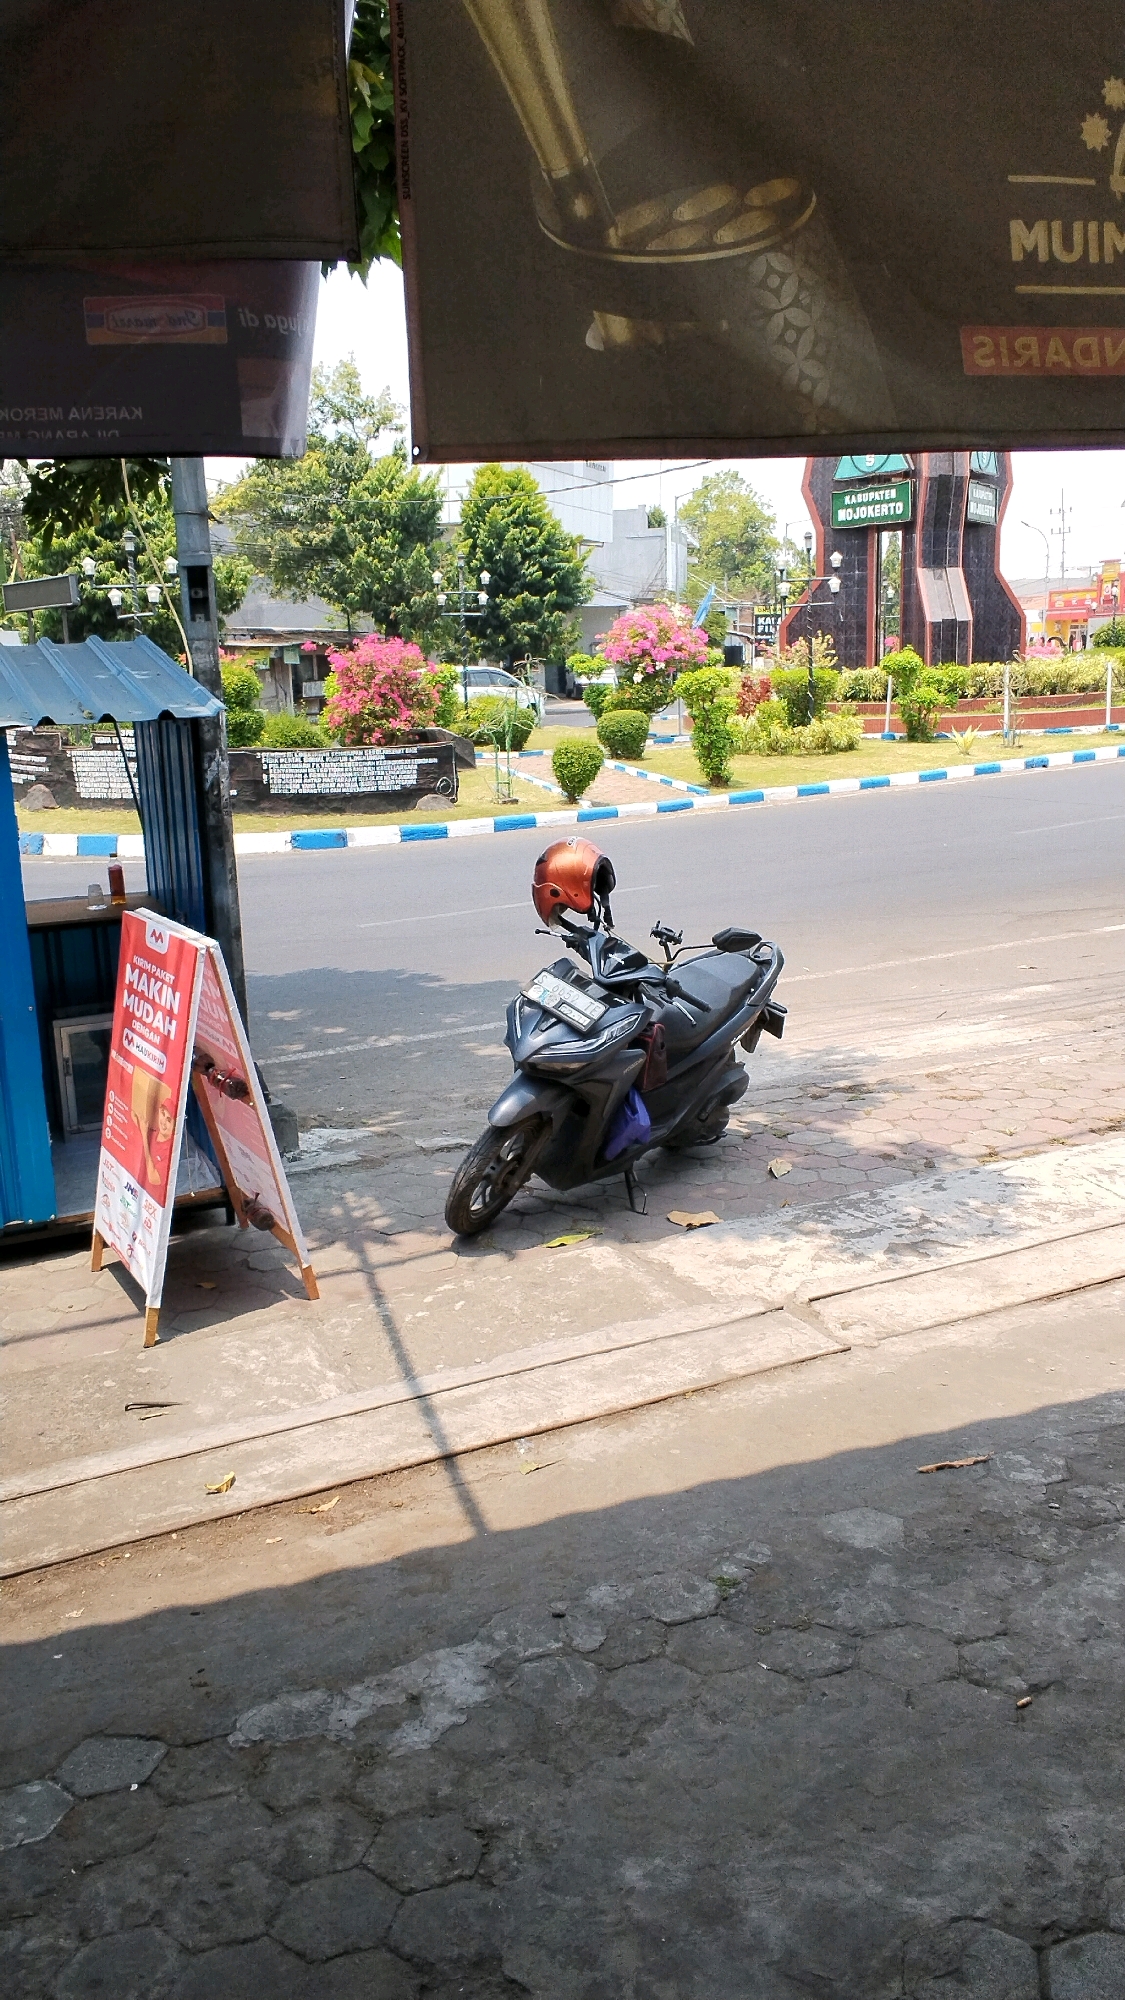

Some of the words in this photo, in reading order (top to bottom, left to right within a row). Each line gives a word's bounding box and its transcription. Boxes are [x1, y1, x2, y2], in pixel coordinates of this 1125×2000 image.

[837, 501, 904, 523] MOJOKERTO
[844, 488, 897, 506] KABUPATEN
[133, 954, 152, 972] KIRIM
[151, 964, 176, 985] PAKET
[125, 962, 181, 1016] MAKIN
[538, 974, 548, 984] S
[584, 1001, 602, 1017] TE
[122, 988, 177, 1041] MUDAH
[131, 1019, 161, 1046] DENGAN
